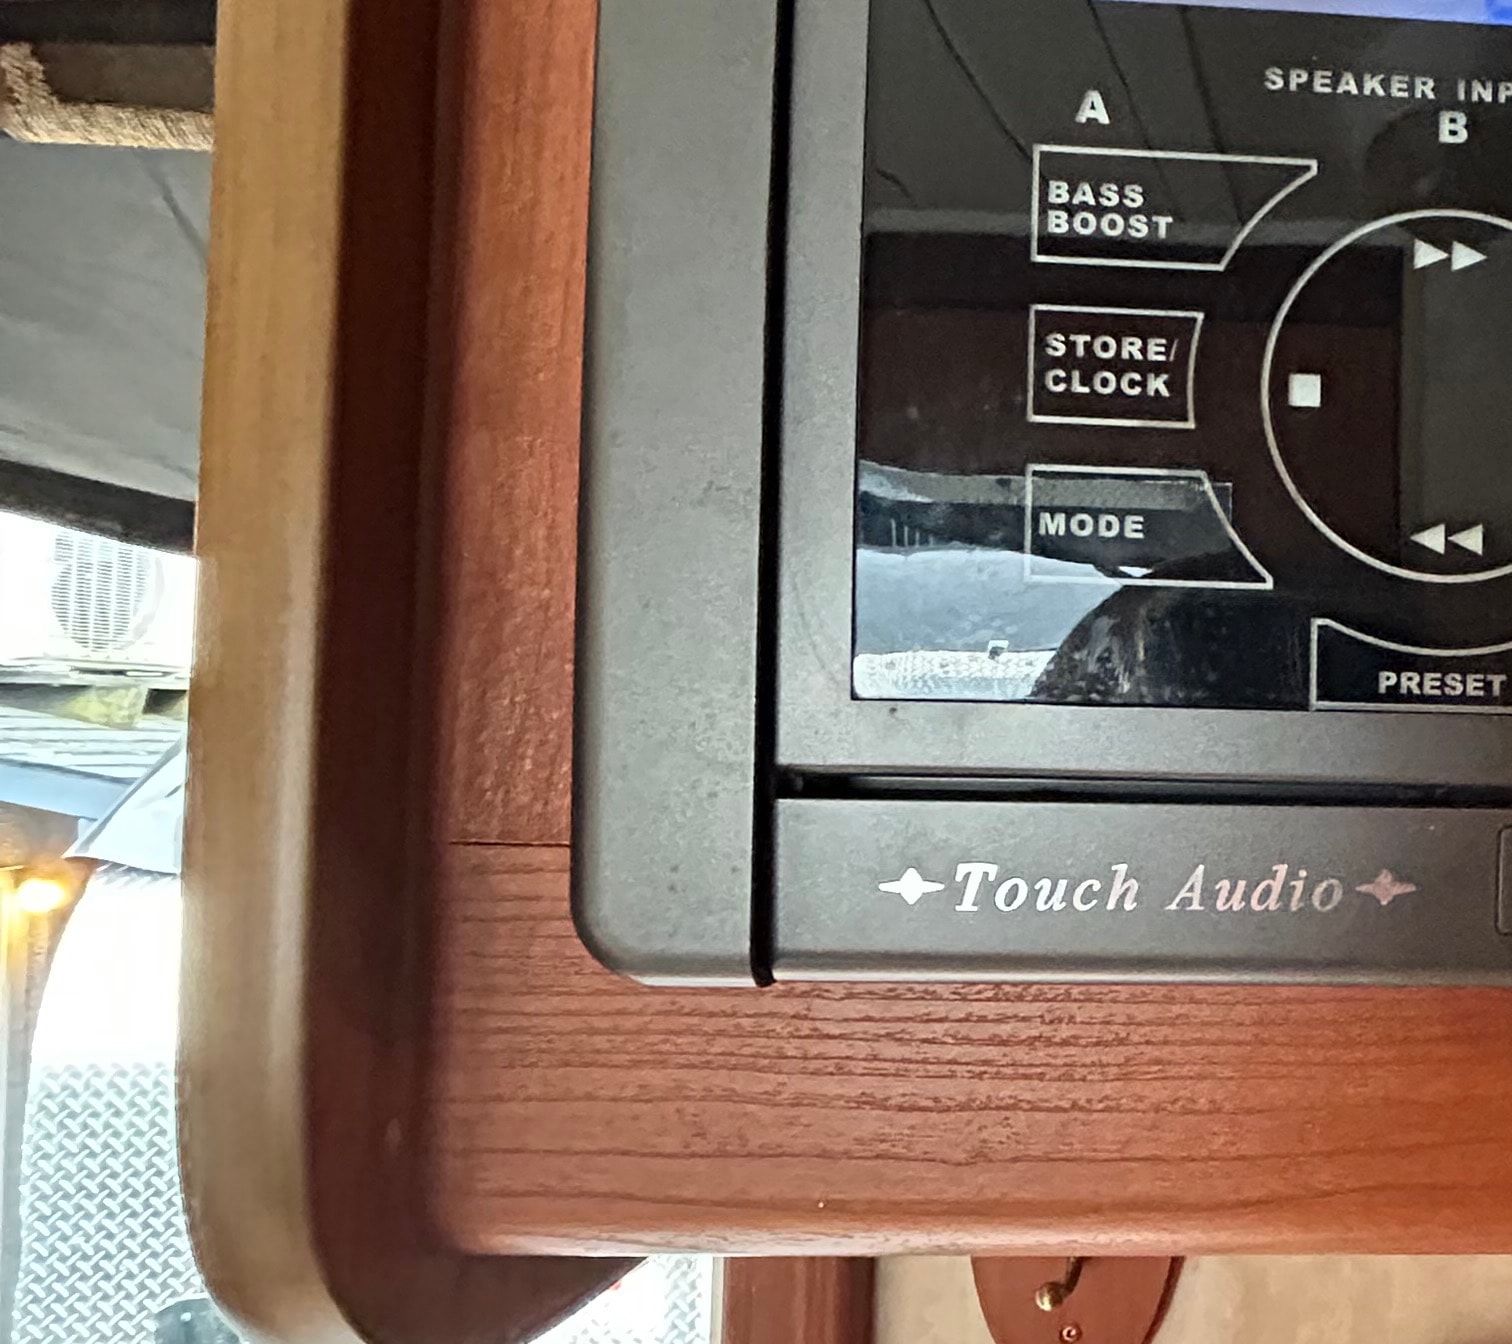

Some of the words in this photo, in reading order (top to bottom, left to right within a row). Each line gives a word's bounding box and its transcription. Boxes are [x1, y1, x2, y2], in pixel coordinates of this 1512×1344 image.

[1263, 67, 1437, 102] SPEAKER
[1074, 90, 1112, 126] A
[1437, 110, 1470, 146] B
[1046, 180, 1145, 209] BASS
[1046, 207, 1175, 240] BOOST
[1044, 332, 1178, 365] STORE/
[1044, 369, 1172, 400] CLOCK
[1037, 510, 1145, 541] MODE
[1377, 671, 1508, 699] PRESET
[951, 861, 1140, 915] Touch
[1165, 864, 1344, 913] Audio
